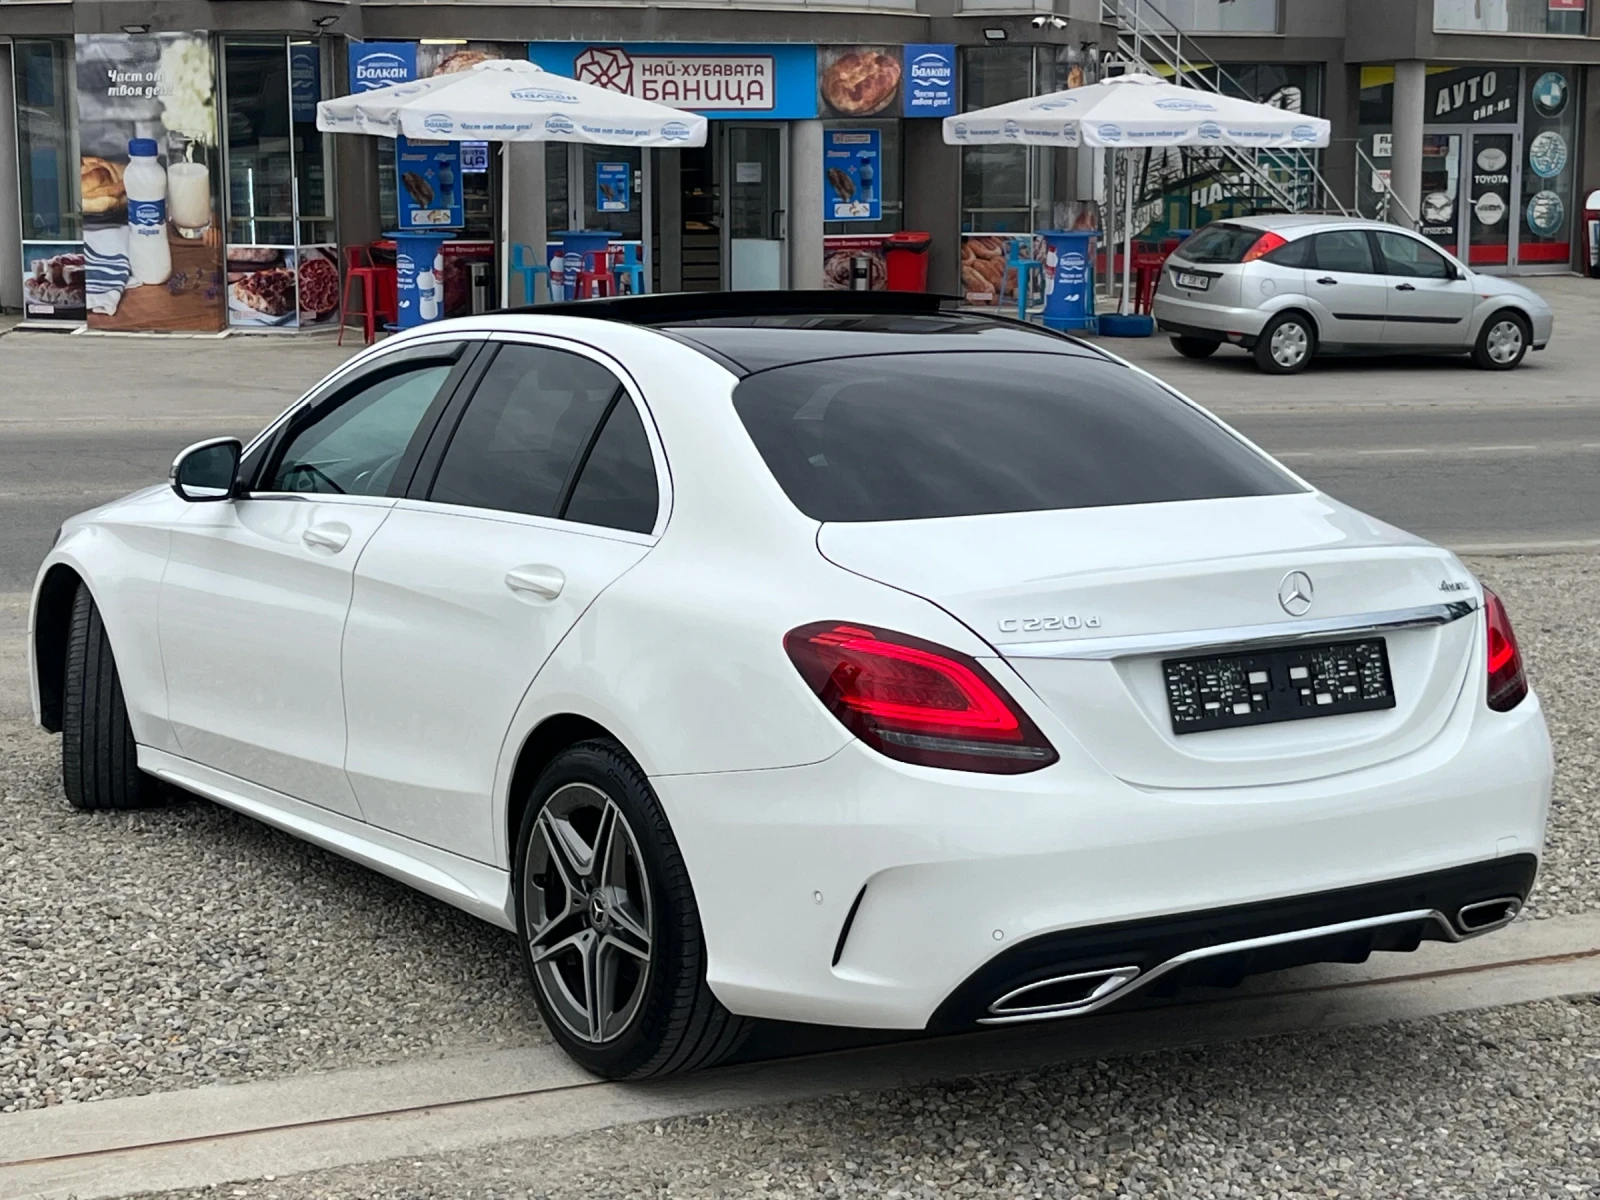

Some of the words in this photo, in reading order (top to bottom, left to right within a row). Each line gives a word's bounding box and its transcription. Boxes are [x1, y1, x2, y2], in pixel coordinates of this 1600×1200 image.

[356, 65, 408, 79] Балкан
[642, 60, 764, 76] НАЙ-ХУБАВАТА
[911, 65, 951, 77] Балкан
[107, 69, 142, 82] Част
[107, 84, 142, 96] твоя
[643, 80, 764, 105] БАНИЦА
[1474, 174, 1508, 184] TOYOTA
[999, 619, 1018, 632] C
